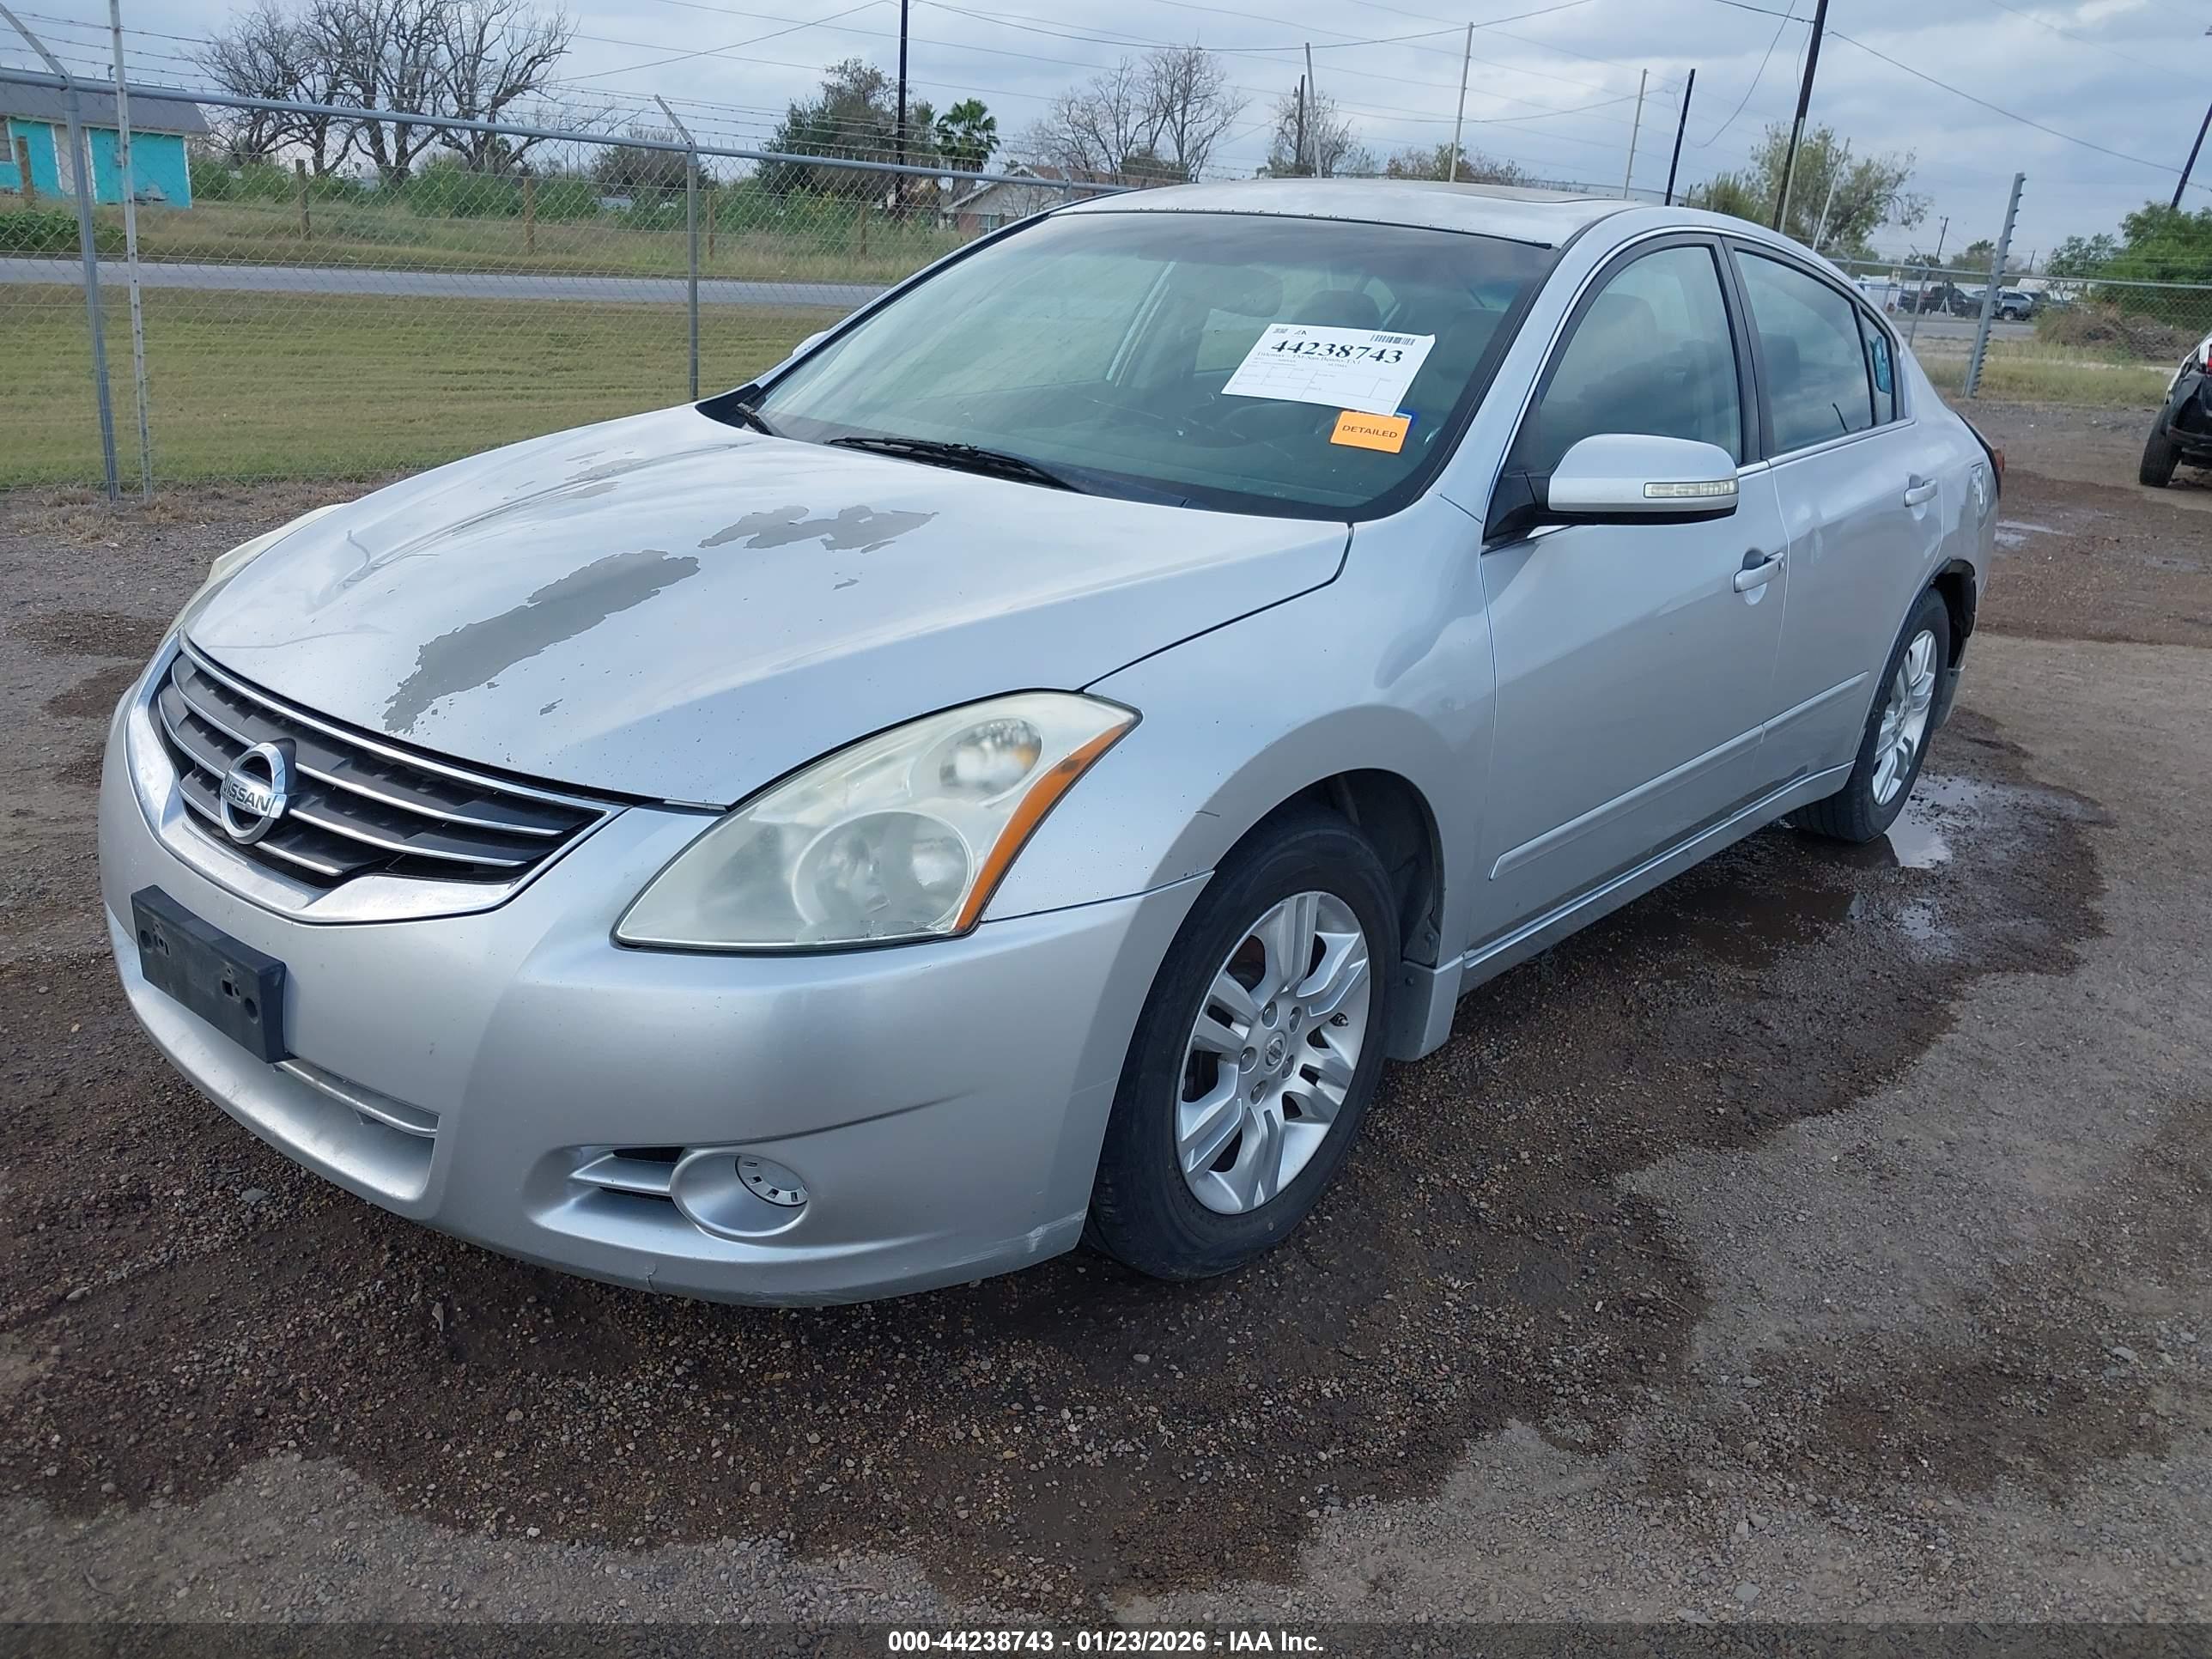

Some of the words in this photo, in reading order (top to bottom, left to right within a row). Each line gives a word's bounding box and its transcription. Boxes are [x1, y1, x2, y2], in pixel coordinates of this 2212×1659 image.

[1271, 339, 1404, 365] 44238743
[1342, 424, 1398, 439] DETAILED
[222, 778, 271, 812] NISSAN
